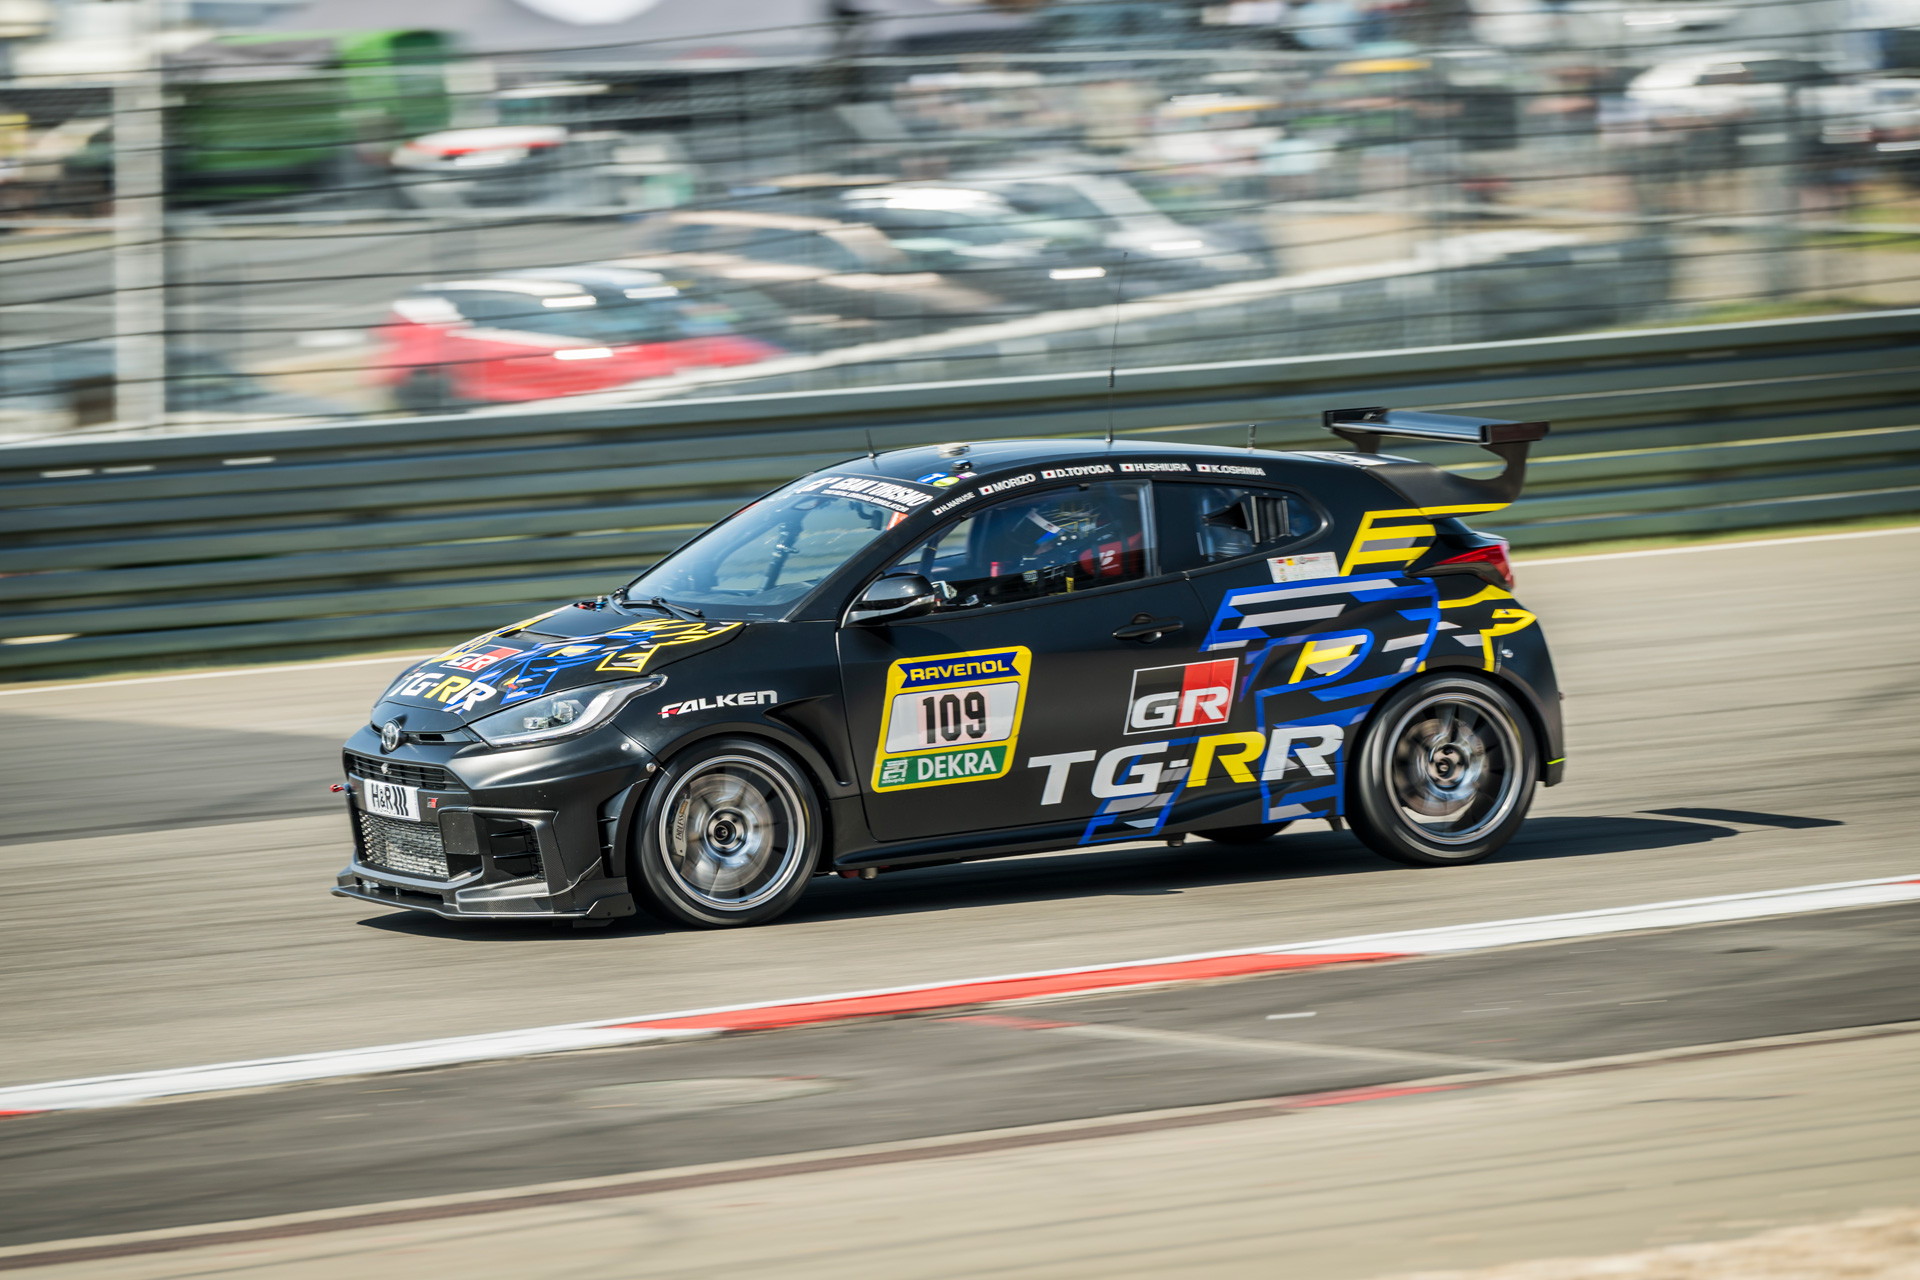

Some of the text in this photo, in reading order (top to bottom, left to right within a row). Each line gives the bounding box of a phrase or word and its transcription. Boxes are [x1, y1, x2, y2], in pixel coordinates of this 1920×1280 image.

[992, 473, 1037, 492] MORIZO
[1055, 464, 1115, 478] D.TOYODA
[446, 653, 498, 670] GR
[910, 660, 1010, 681] RAVENOL
[388, 672, 498, 712] TG-RR
[658, 690, 778, 719] FALKEN
[922, 691, 987, 745] 109
[1130, 686, 1229, 729] GR
[917, 750, 997, 781] DEKRA
[1027, 724, 1345, 806] TG-RR
[371, 782, 393, 811] H&R
